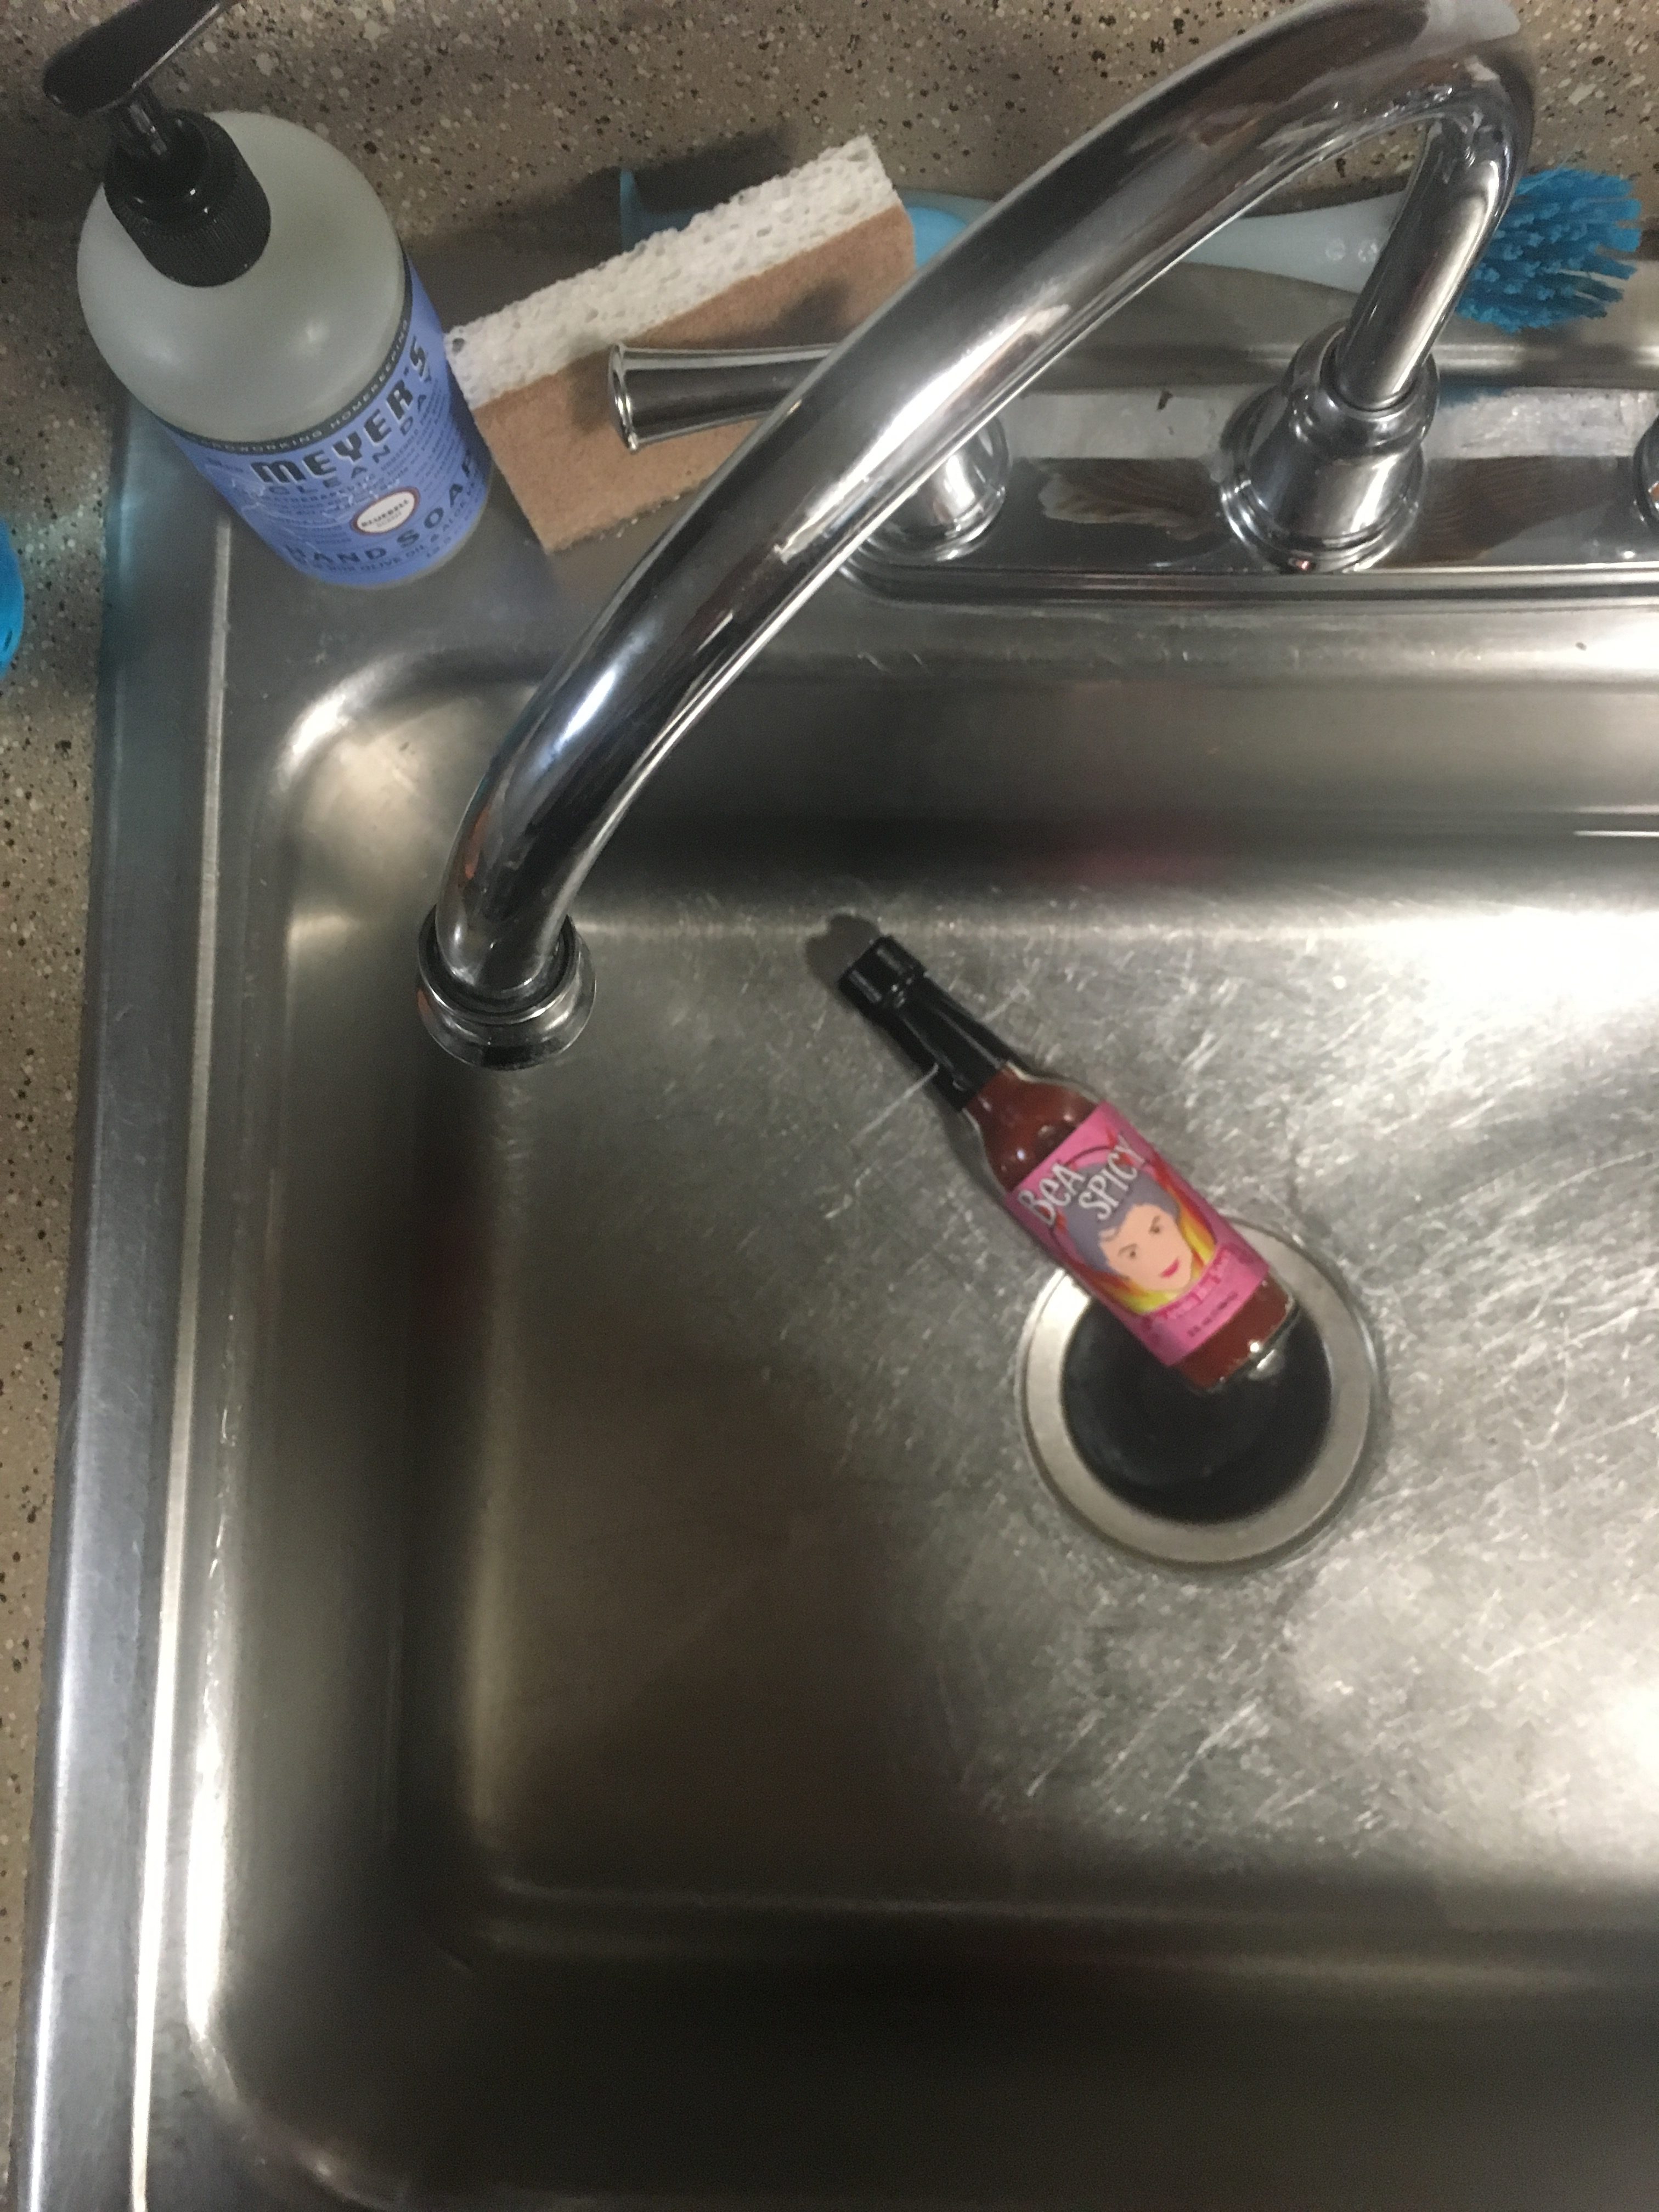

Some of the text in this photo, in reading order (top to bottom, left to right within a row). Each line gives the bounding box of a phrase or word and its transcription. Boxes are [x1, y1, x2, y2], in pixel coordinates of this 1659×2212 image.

[250, 335, 427, 483] MEYER'S
[268, 444, 391, 494] CLEAN
[396, 449, 471, 549] SOAP
[1018, 1163, 1086, 1226] BEA
[1078, 1133, 1145, 1221] SPICY
